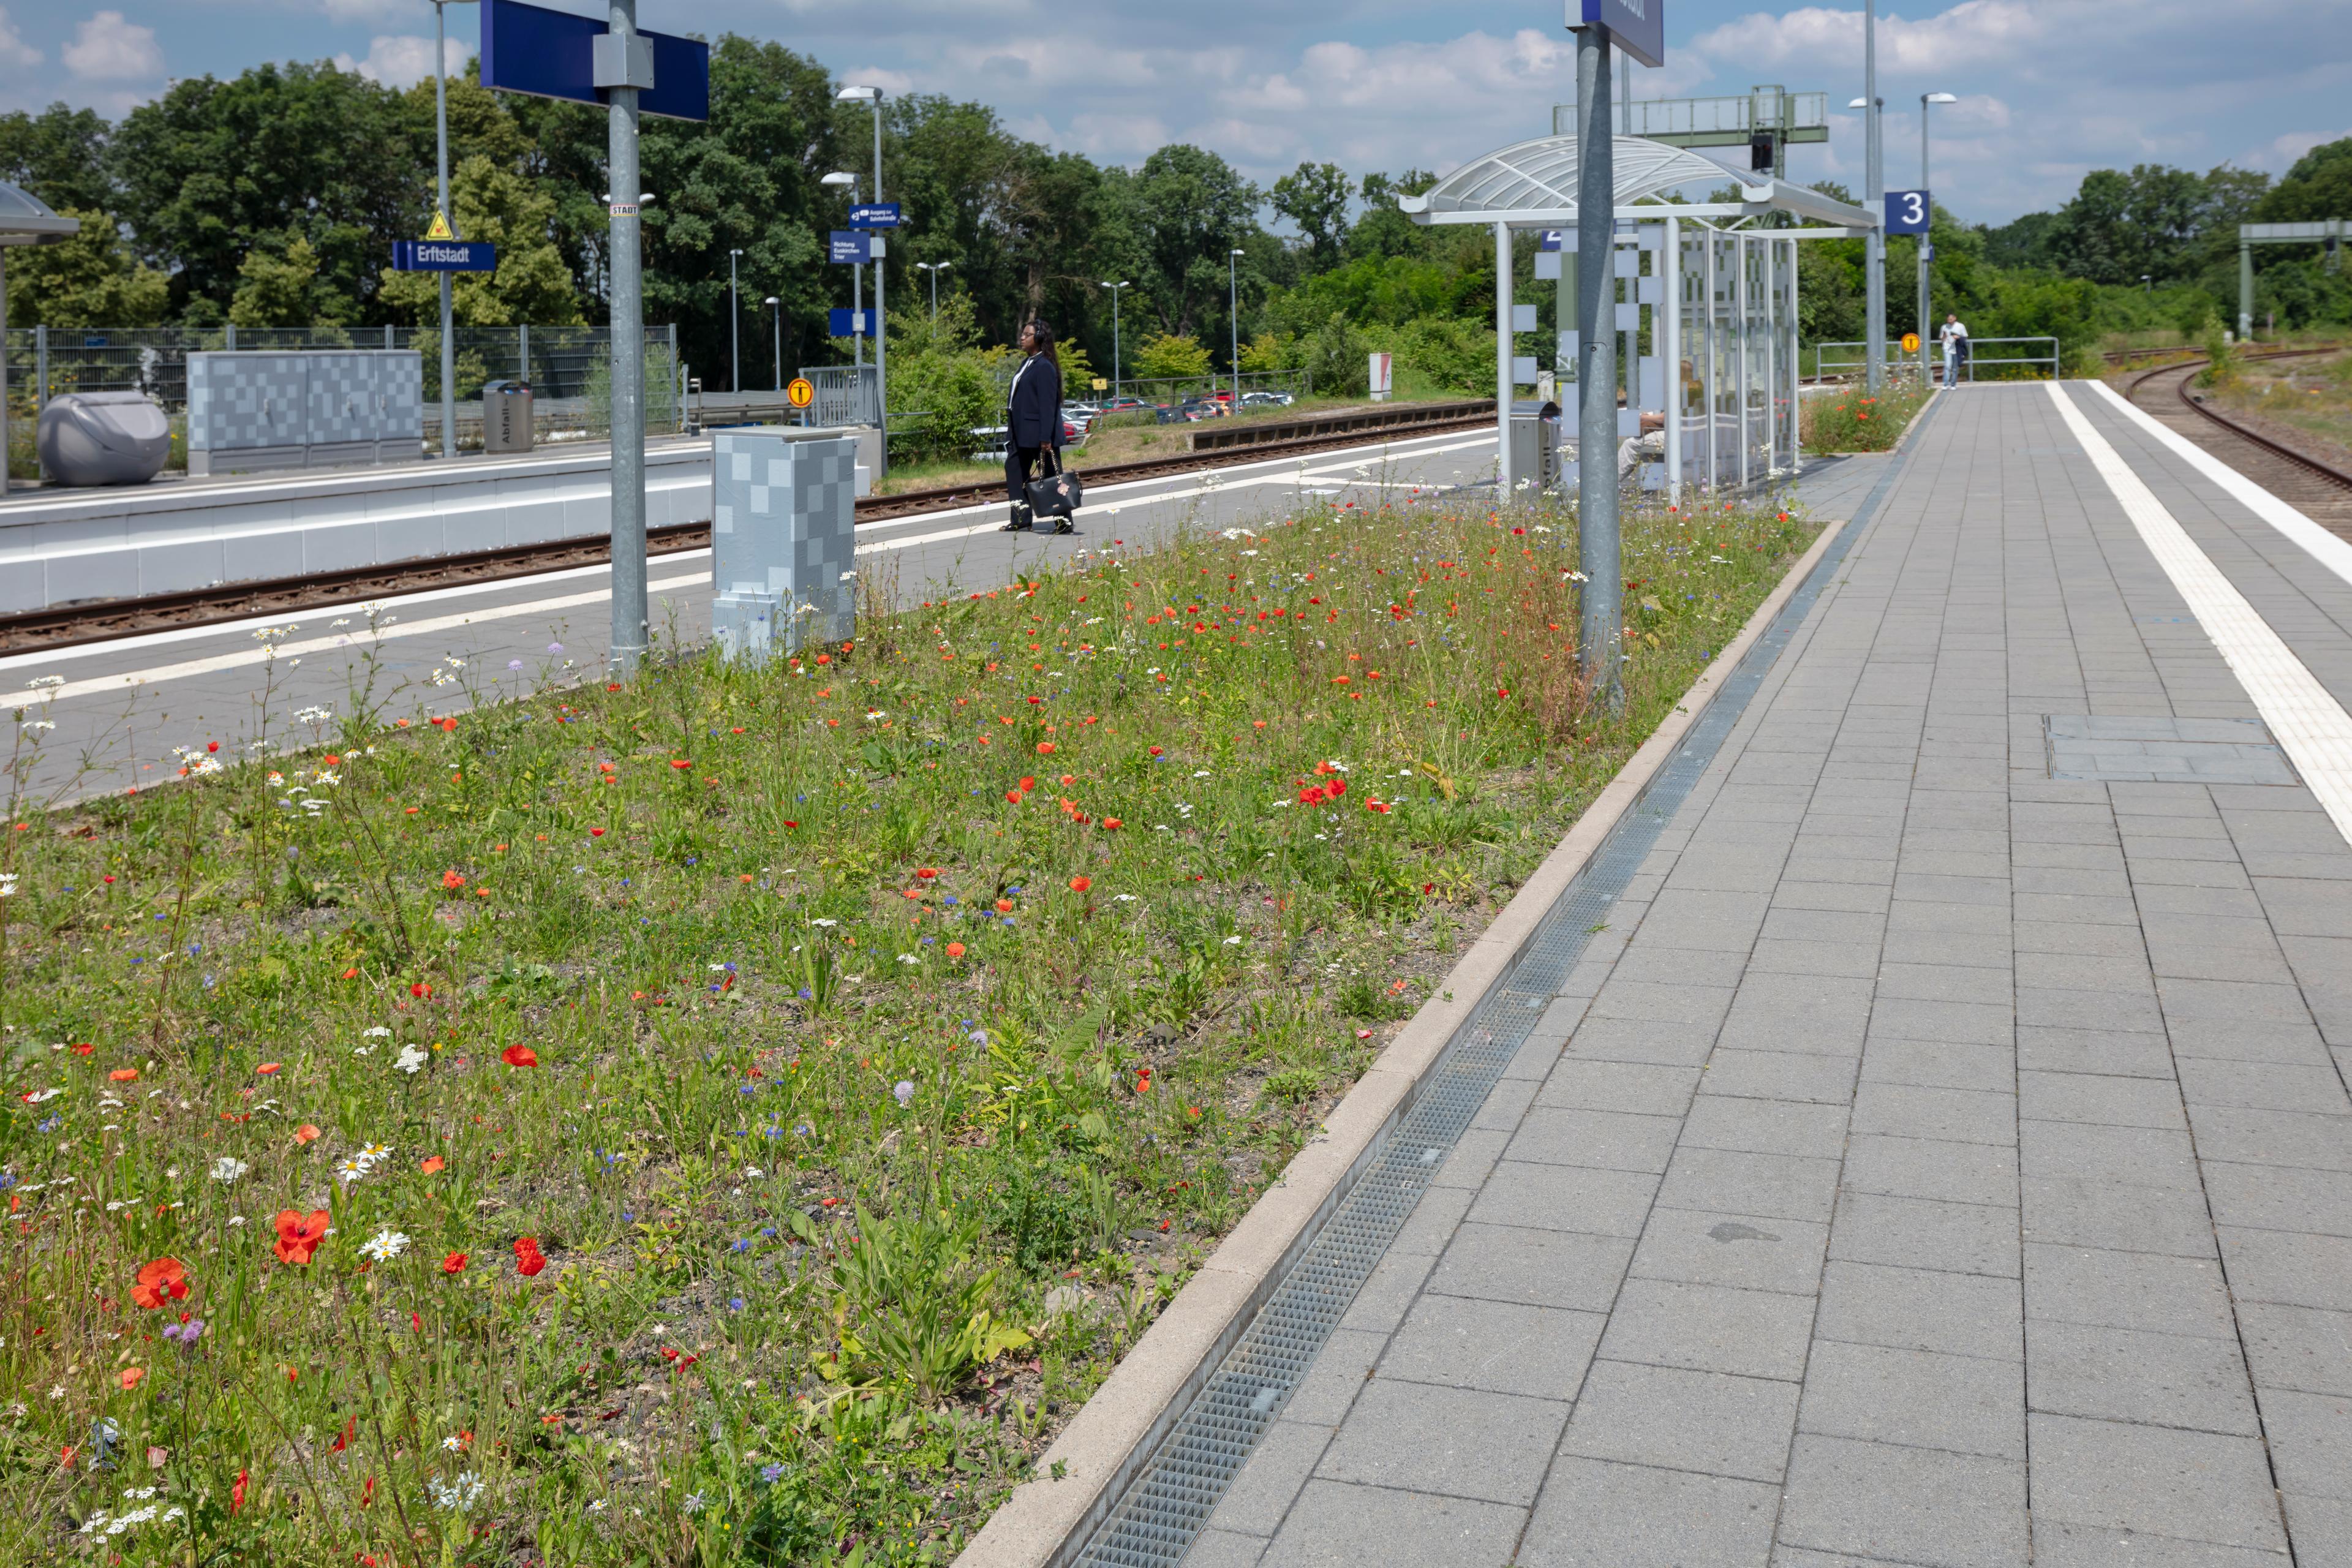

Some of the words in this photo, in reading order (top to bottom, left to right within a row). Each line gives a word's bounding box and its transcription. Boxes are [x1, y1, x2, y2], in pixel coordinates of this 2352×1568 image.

[1901, 192, 1924, 225] 3
[417, 245, 470, 262] Erftstadt
[502, 408, 510, 444] Abfall
